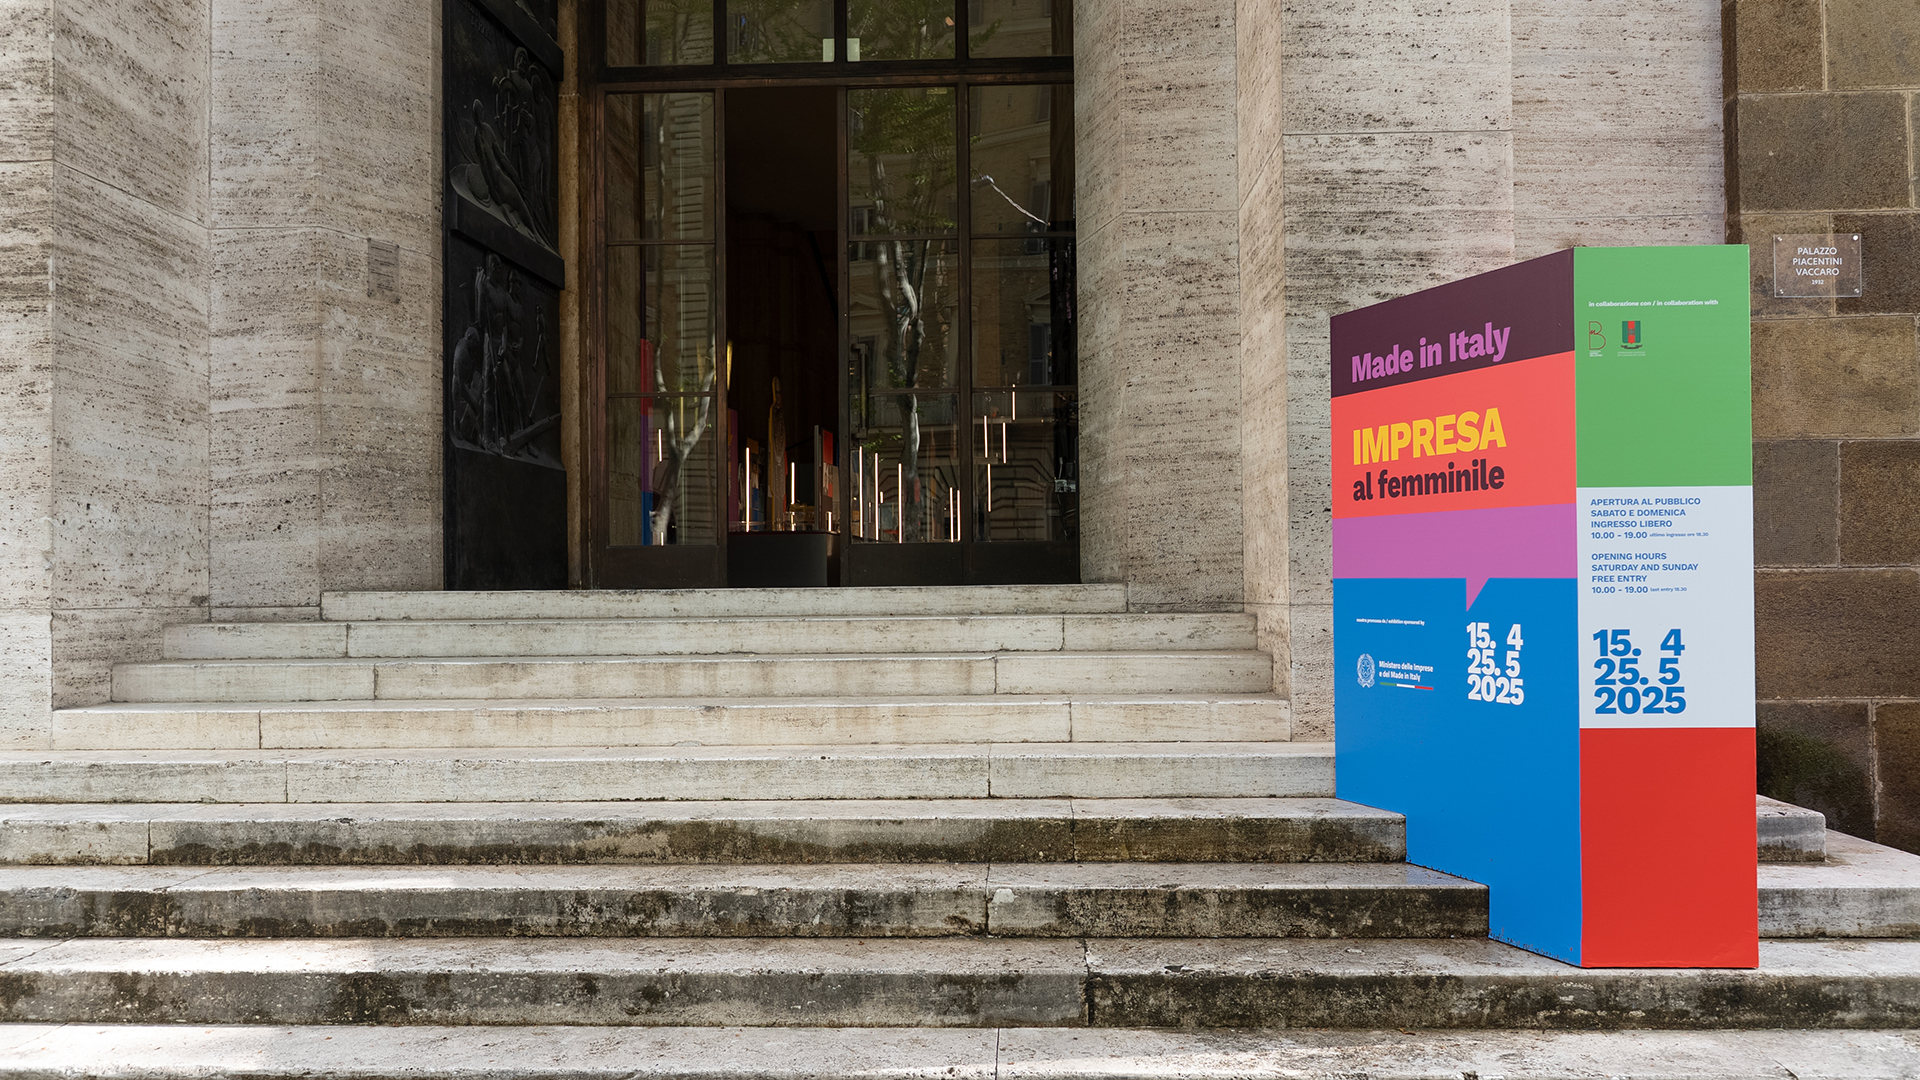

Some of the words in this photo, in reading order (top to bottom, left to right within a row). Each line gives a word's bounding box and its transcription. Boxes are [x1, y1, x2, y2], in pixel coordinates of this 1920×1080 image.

[1352, 344, 1414, 383] Made
[1420, 337, 1442, 368] in
[1450, 322, 1511, 362] Italy
[1353, 408, 1507, 465] IMPRESA
[1353, 472, 1373, 501] al
[1378, 459, 1504, 499] femminile
[1467, 622, 1496, 648] 15.
[1507, 624, 1523, 650] 4
[1593, 629, 1642, 656] 15.
[1660, 629, 1685, 656] 4
[1379, 661, 1400, 669] Ministero
[1414, 664, 1433, 672] Imprese
[1467, 648, 1500, 676] 25.
[1505, 651, 1520, 677] 5
[1594, 658, 1649, 685] 25.
[1658, 658, 1680, 684] 5
[1410, 673, 1420, 682] Italy
[1467, 675, 1524, 705] 2025
[1595, 686, 1686, 714] 2025
